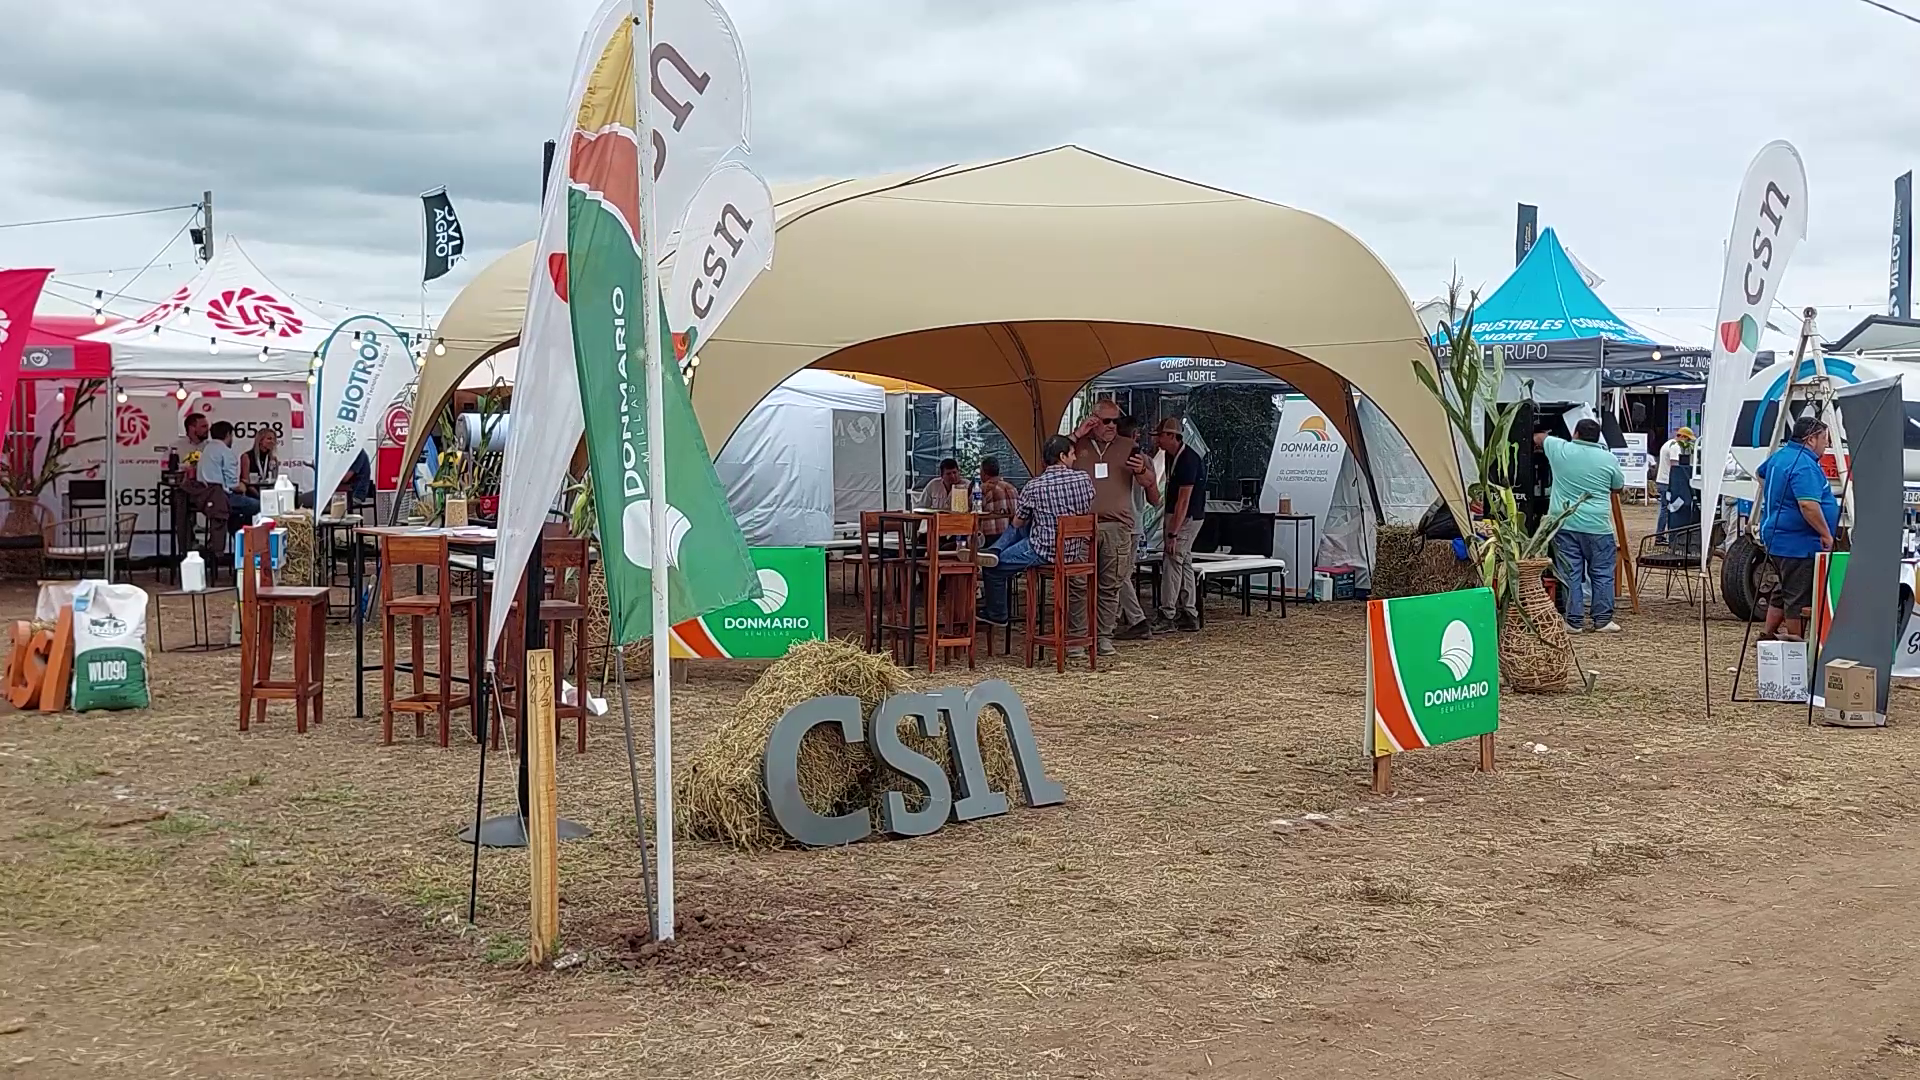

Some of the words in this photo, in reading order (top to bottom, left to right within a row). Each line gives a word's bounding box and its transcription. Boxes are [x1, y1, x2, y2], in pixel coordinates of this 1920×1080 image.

[434, 208, 448, 257] AGRO
[1744, 181, 1790, 306] csn
[691, 203, 754, 319] csn
[235, 304, 274, 326] LG
[1480, 332, 1538, 341] NORTE
[1680, 356, 1695, 368] DEL
[337, 330, 382, 422] BIOTROP
[1168, 371, 1186, 383] DEL
[1187, 370, 1217, 381] NORTE
[612, 286, 646, 498] DONMARIO
[120, 416, 137, 434] LG
[629, 384, 650, 477] MILLAS
[1280, 442, 1339, 453] DONMARIO
[724, 617, 809, 629] DONMARIO
[1424, 681, 1489, 707] DONMARIO
[1440, 701, 1475, 715] SEMILLAS
[763, 679, 1066, 847] csn
